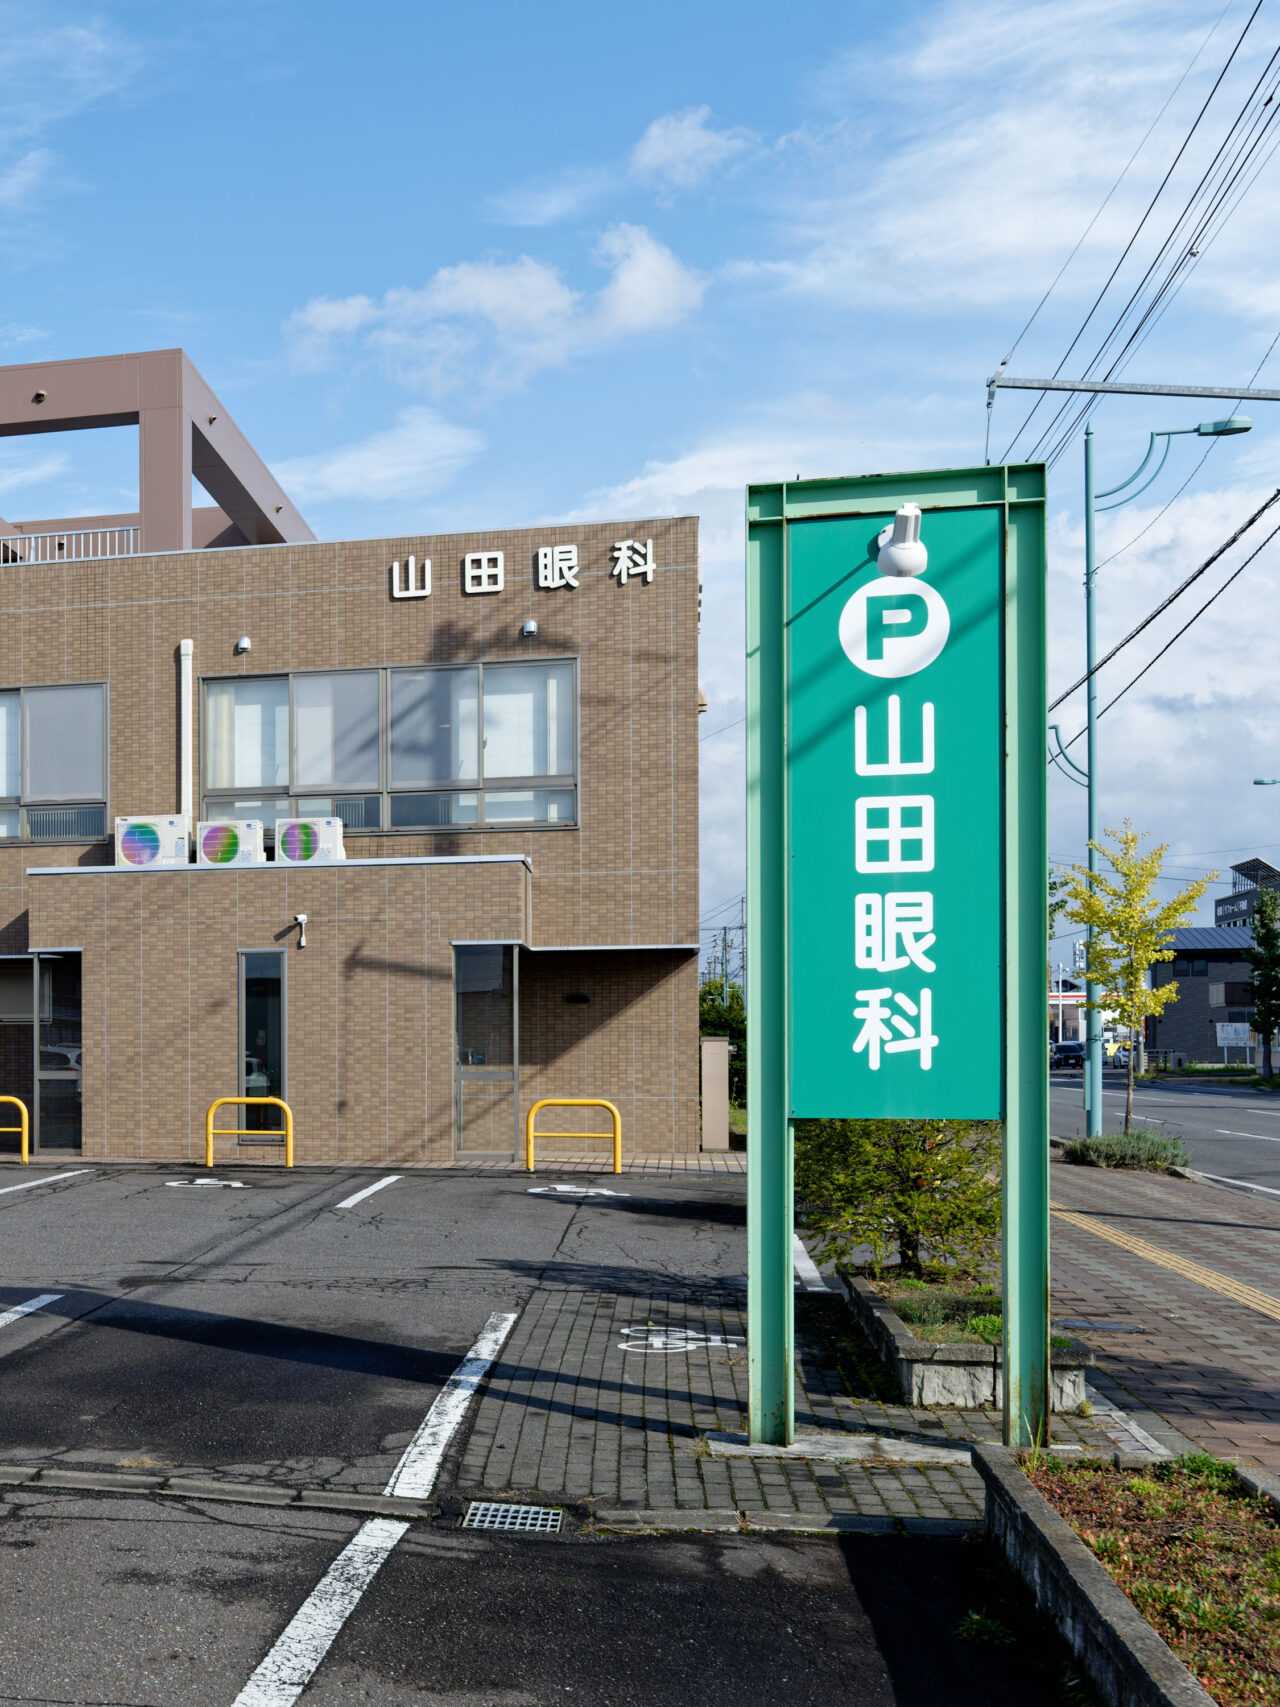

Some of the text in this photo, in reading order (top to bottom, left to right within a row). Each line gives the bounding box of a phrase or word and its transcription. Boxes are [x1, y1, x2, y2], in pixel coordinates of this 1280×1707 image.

[392, 538, 657, 598] 山田眼科
[866, 593, 929, 660] P
[853, 694, 940, 1072] 山田眼科
